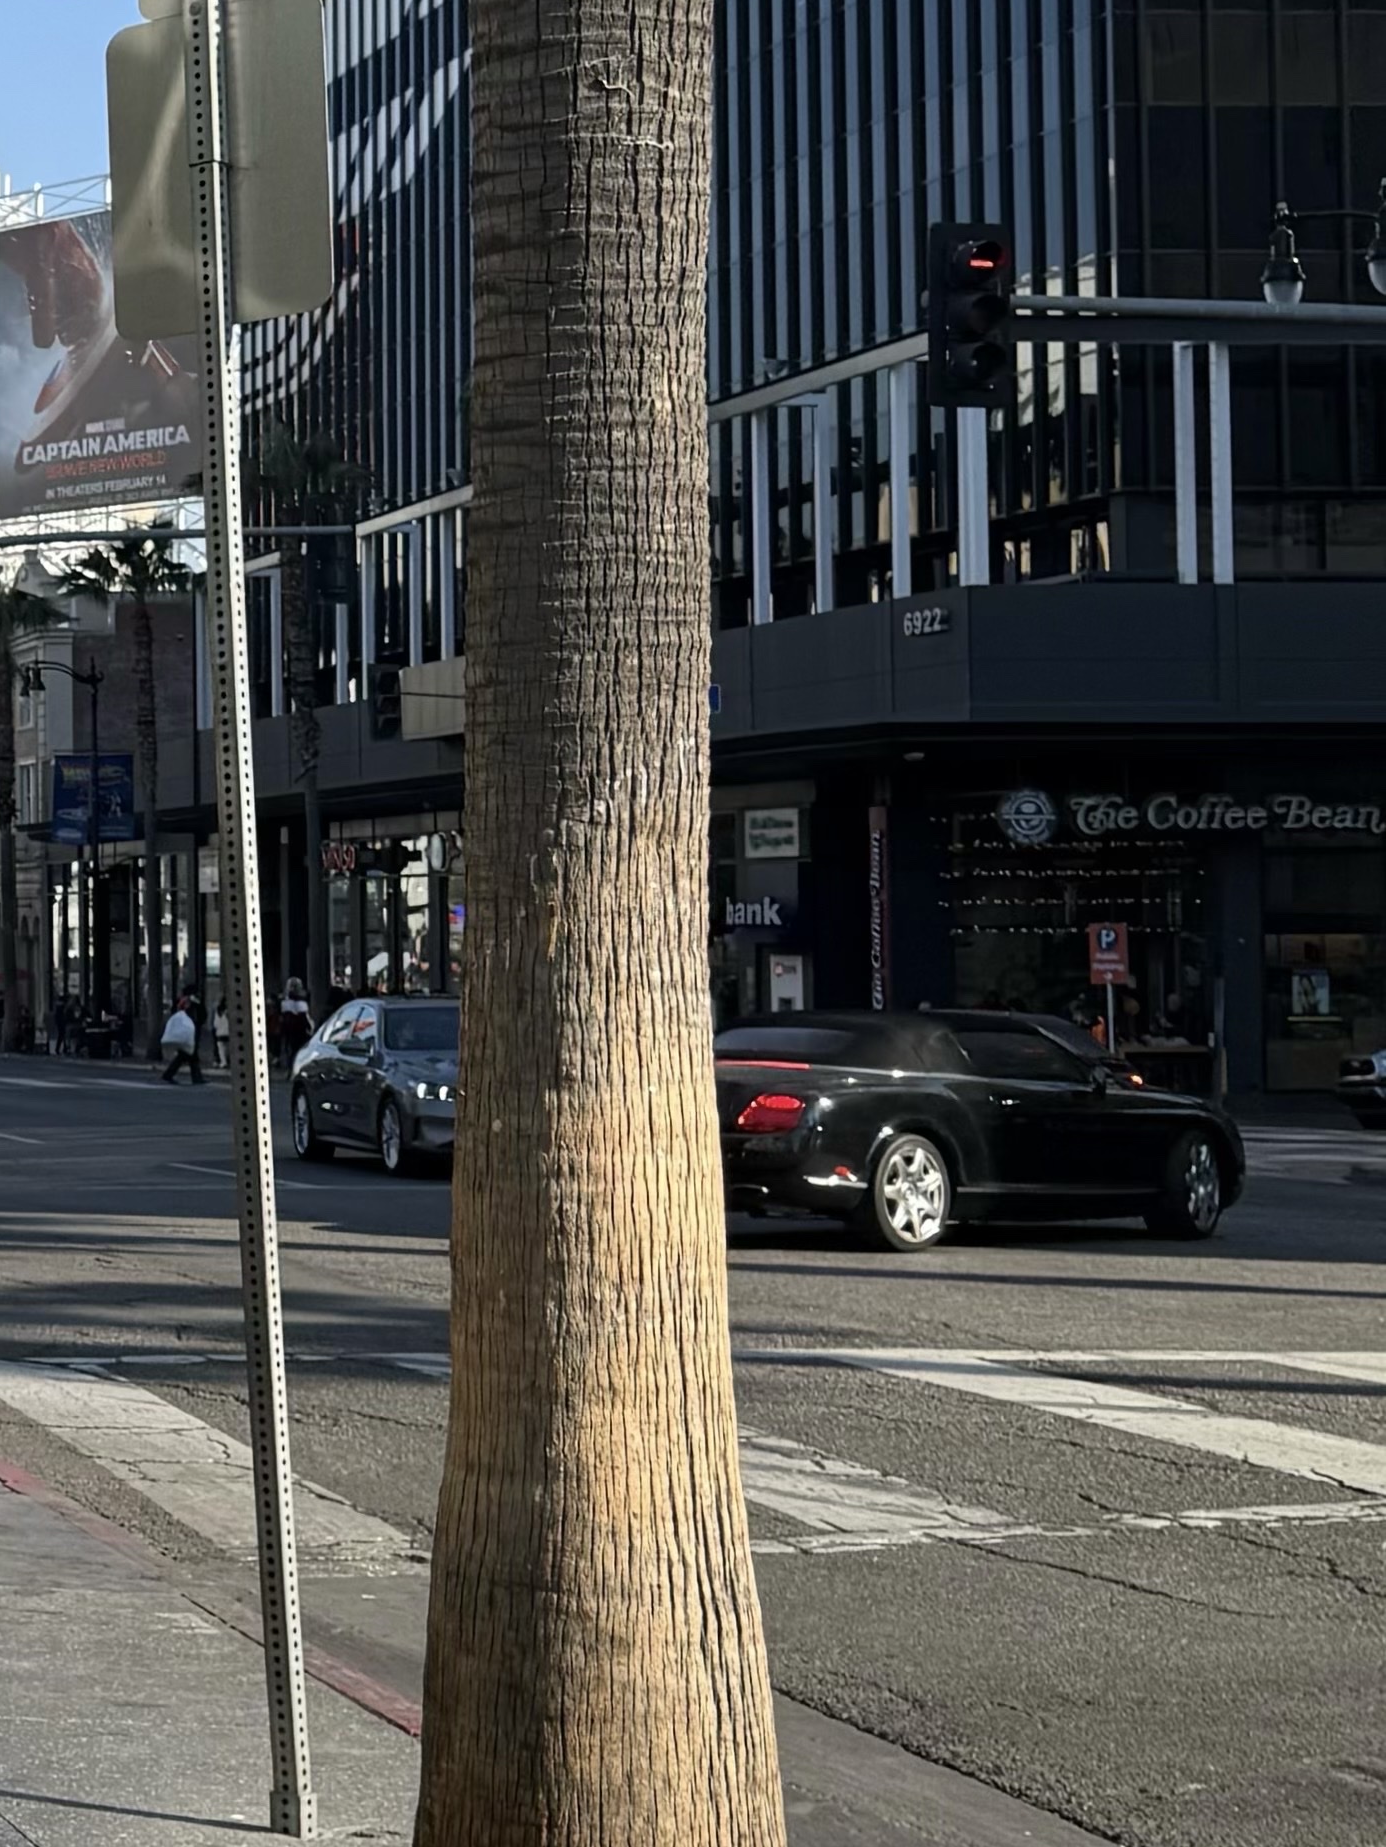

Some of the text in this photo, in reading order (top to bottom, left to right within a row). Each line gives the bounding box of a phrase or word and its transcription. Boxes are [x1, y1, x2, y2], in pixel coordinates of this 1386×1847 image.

[22, 436, 100, 465] CAPTAIN
[103, 424, 191, 455] AMERICA
[57, 481, 104, 499] THEATERS
[104, 476, 154, 493] FEBRUARY
[903, 607, 942, 636] 6922
[1070, 795, 1139, 835] The
[1147, 793, 1268, 830] Coffee
[1272, 795, 1386, 834] Bean
[1101, 929, 1116, 949] P
